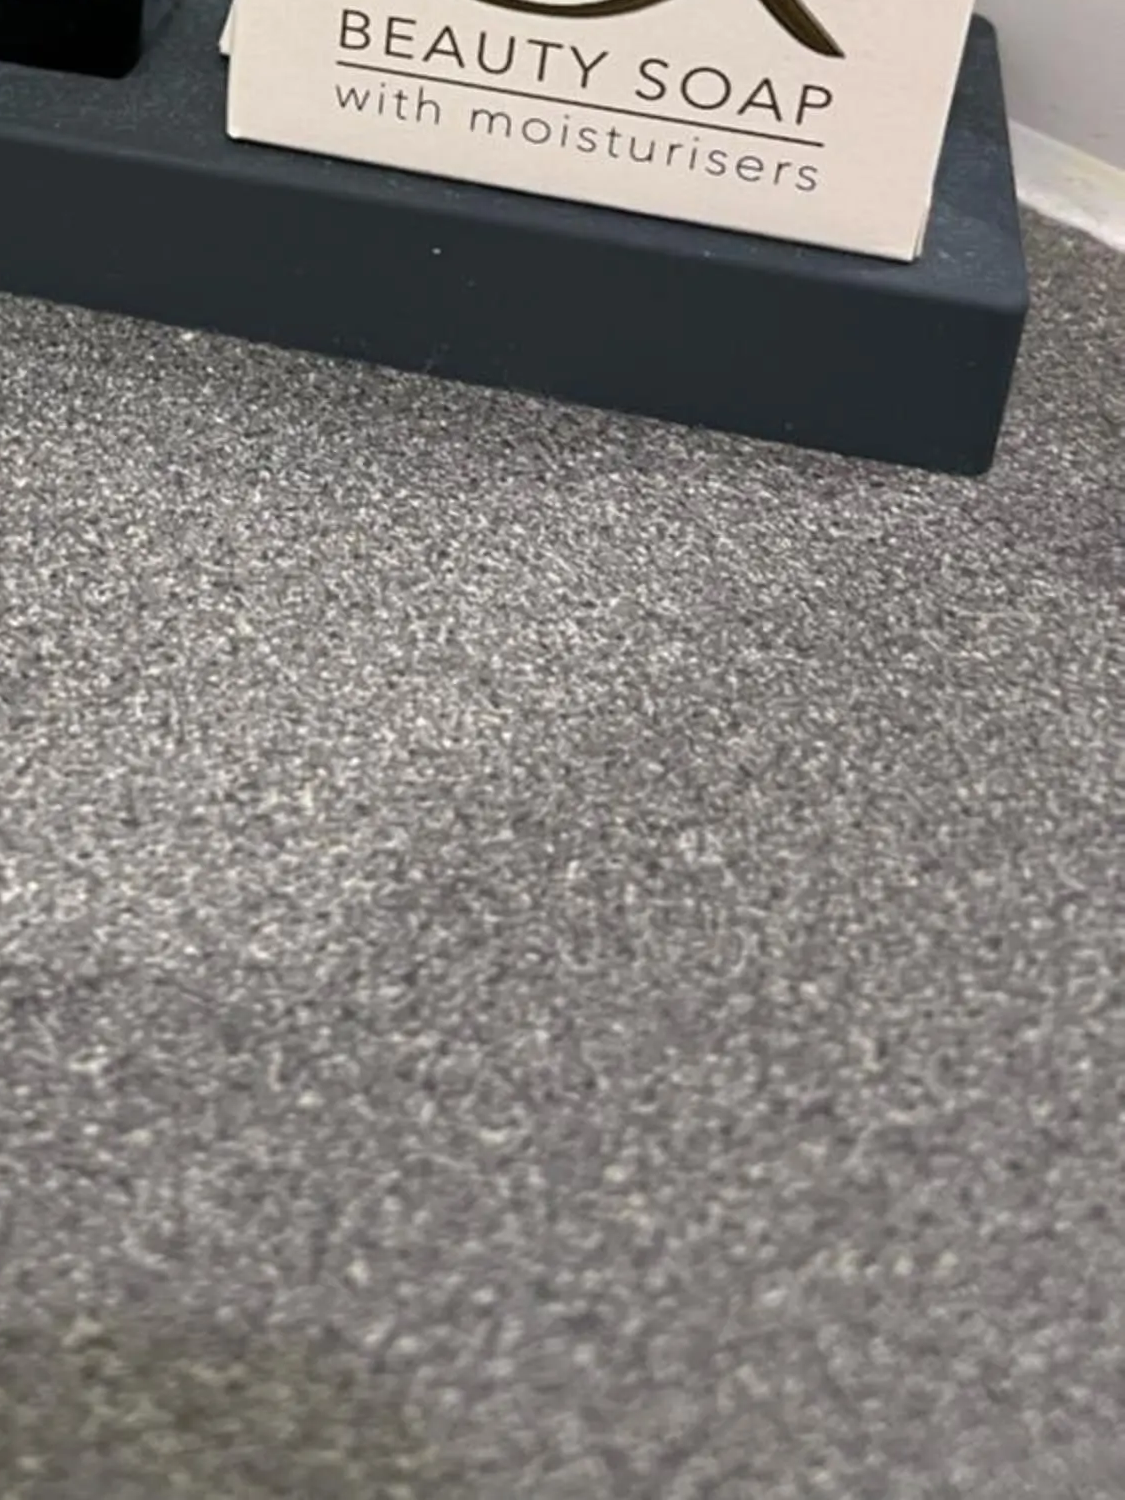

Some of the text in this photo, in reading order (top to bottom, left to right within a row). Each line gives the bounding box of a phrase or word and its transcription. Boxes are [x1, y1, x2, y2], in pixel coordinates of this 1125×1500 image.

[337, 8, 835, 128] BEAUTY SOAP
[335, 82, 820, 193] with moisturisers
